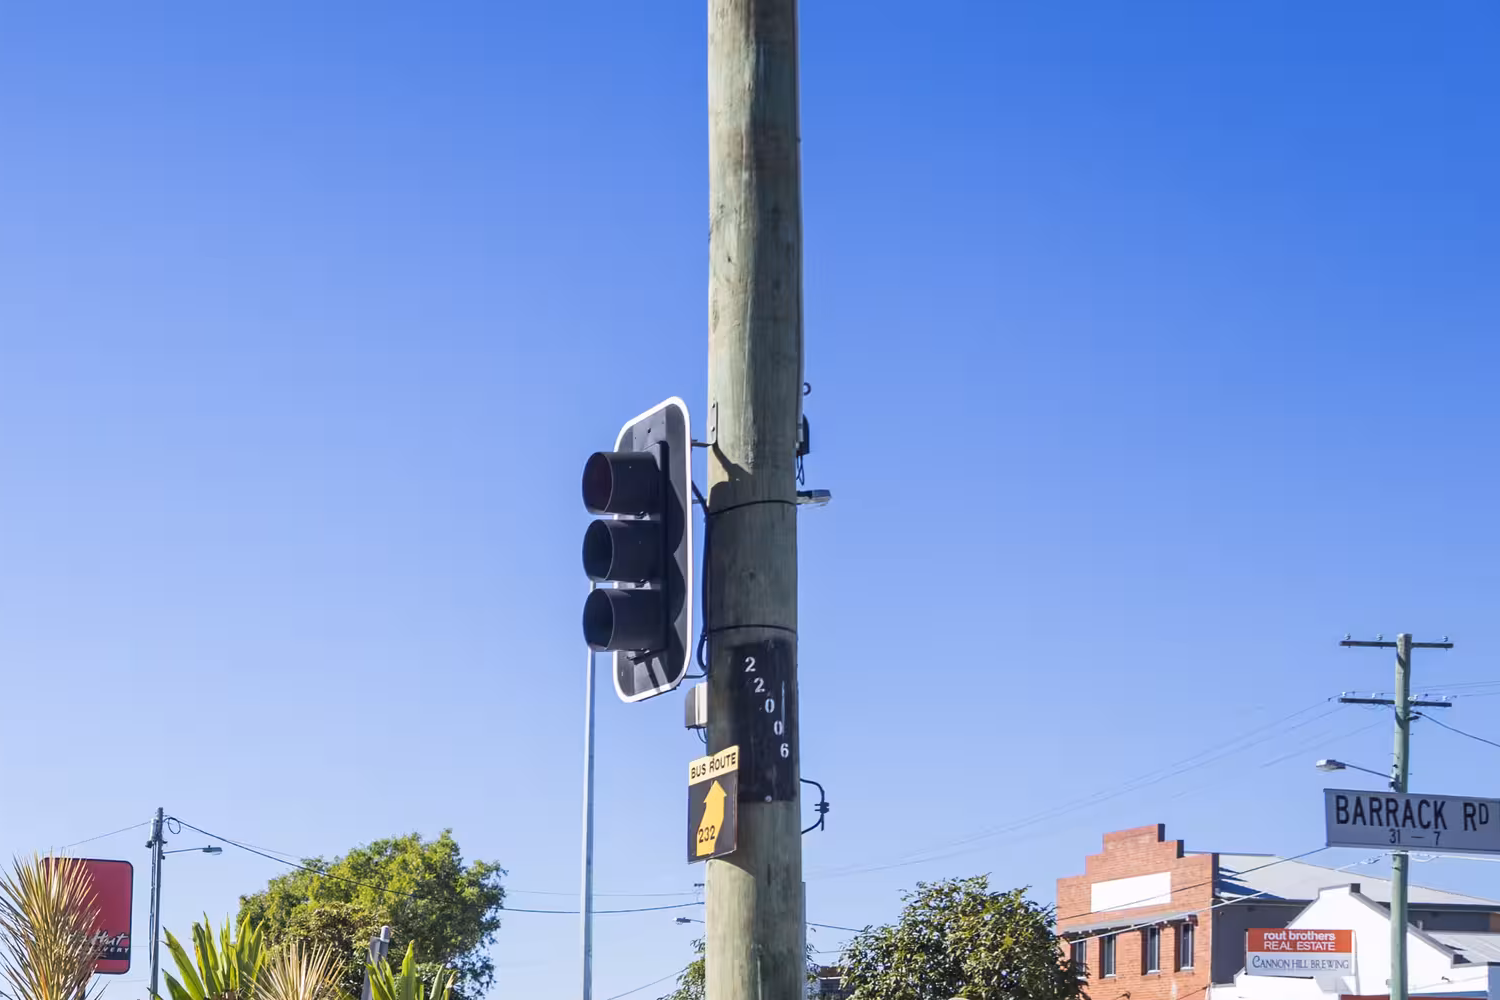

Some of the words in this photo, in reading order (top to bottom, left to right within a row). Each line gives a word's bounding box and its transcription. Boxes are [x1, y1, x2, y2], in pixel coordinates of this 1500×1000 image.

[690, 763, 707, 779] BUS
[708, 752, 737, 773] ROUTE
[1335, 794, 1448, 830] BARRACK
[1463, 801, 1489, 832] RD
[698, 825, 716, 844] 232
[1389, 828, 1401, 844] 31
[1433, 831, 1441, 846] 7
[1263, 931, 1287, 941] rout
[1288, 930, 1336, 941] brothers
[1263, 941, 1293, 950] REAL
[1296, 941, 1336, 951] ESTATE
[1291, 959, 1308, 969] HILL
[1310, 959, 1349, 969] BREWING
